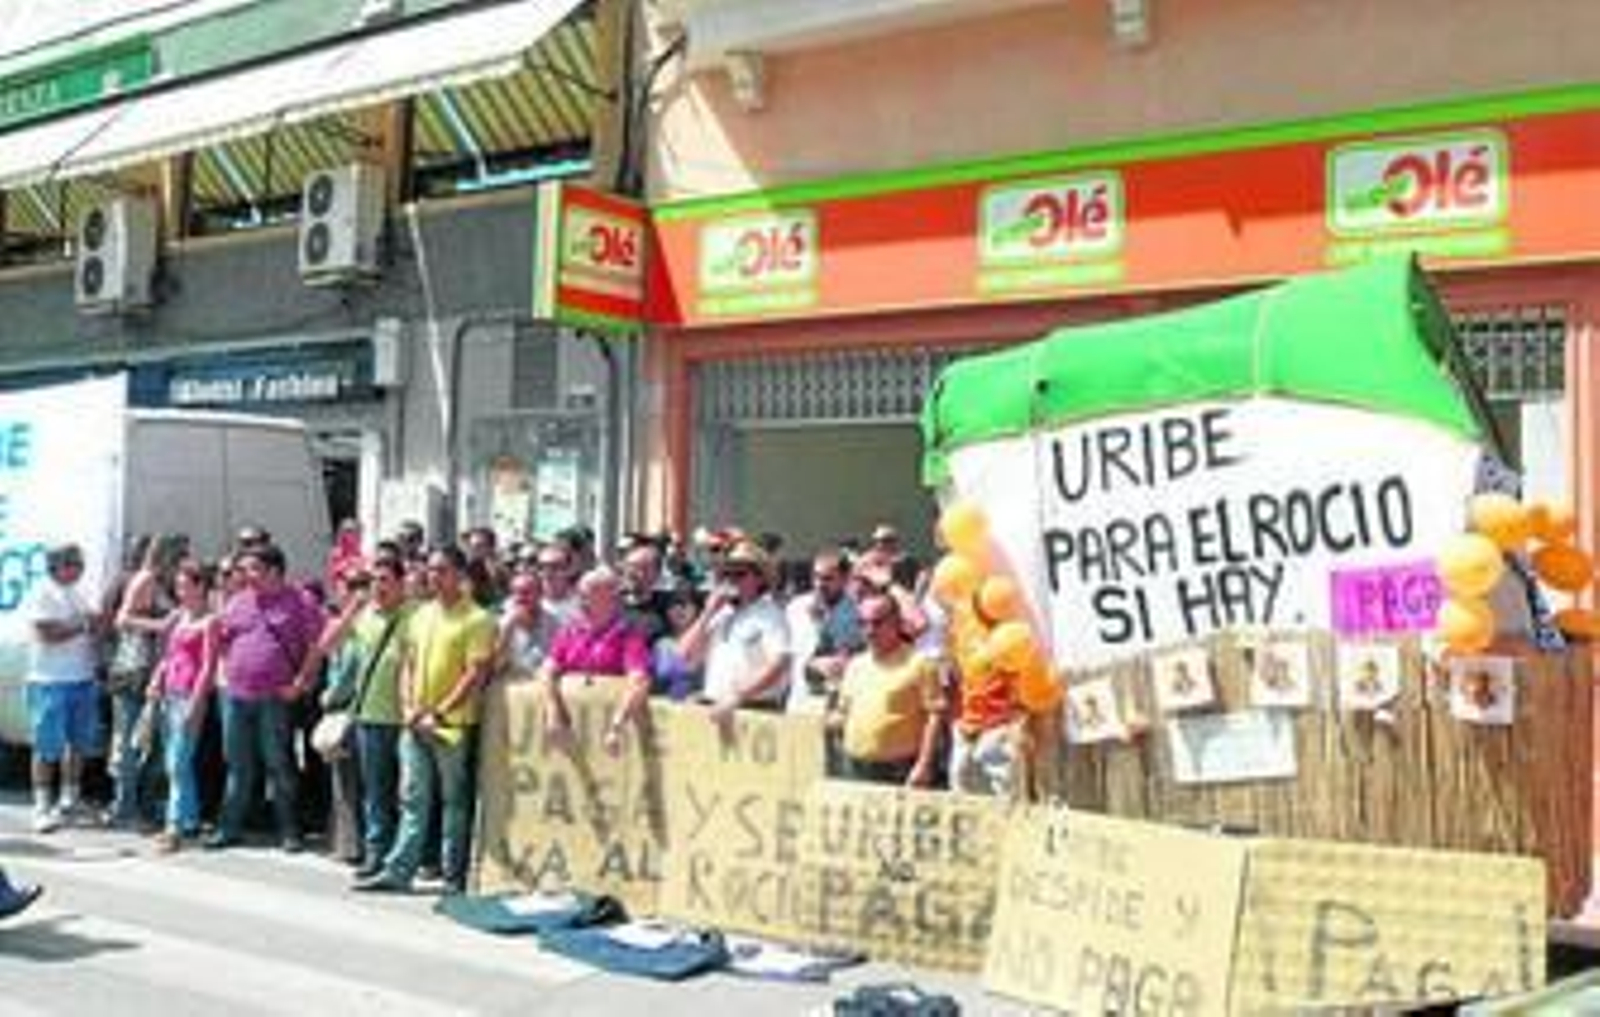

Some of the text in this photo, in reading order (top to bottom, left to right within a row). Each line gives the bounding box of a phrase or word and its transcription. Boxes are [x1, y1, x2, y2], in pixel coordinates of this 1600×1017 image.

[1382, 145, 1489, 218] Olé
[1024, 184, 1107, 247] Olé
[1052, 409, 1238, 503] URIBE
[1043, 511, 1178, 593] PARA
[1094, 586, 1154, 643] SI
[685, 780, 722, 839] Y
[598, 840, 666, 881] AL
